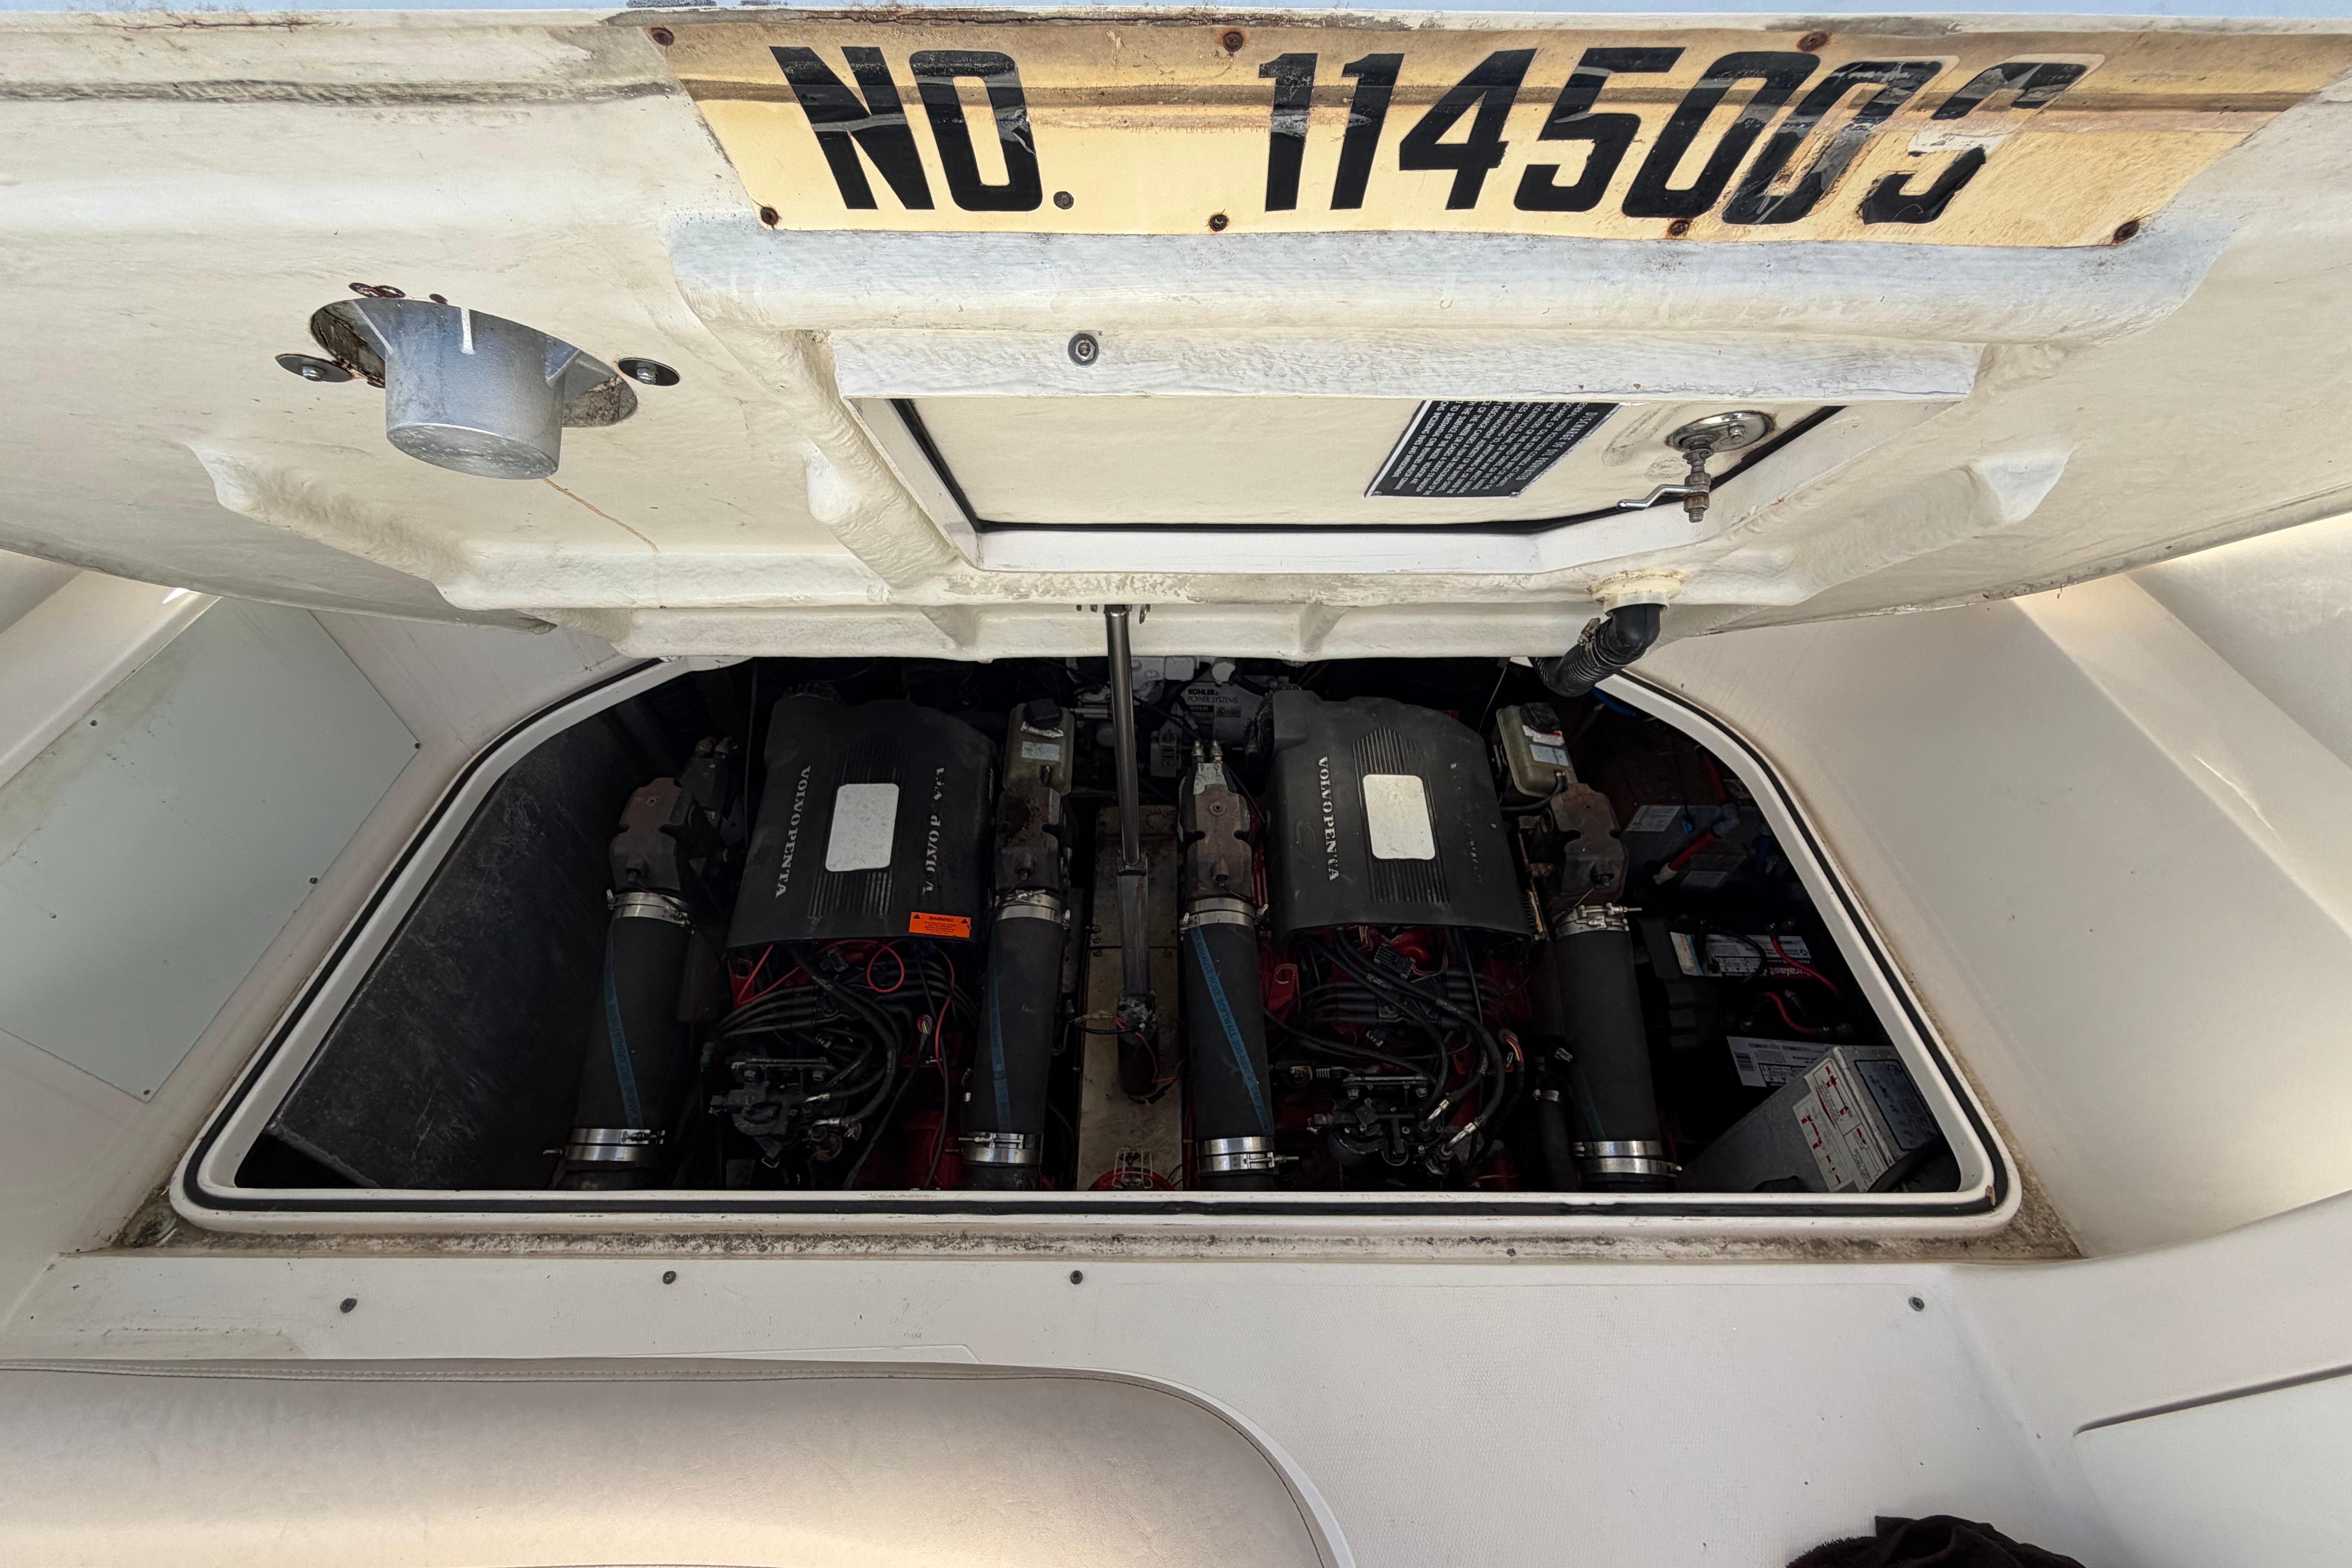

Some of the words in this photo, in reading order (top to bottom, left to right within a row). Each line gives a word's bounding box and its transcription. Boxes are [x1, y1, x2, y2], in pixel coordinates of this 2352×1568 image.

[1447, 416, 1467, 432] SURFACE
[1476, 406, 1503, 428] DISCHARGE
[1481, 411, 1512, 438] MANAGEMENT
[1496, 413, 1524, 436] BELONGING
[1512, 405, 1545, 432] CONTIGUOUS
[1529, 413, 1551, 428] WATERS
[1552, 418, 1573, 431] WATER
[1557, 412, 1600, 441] DISCHARGE
[1458, 423, 1475, 435] WATER
[1464, 429, 1483, 443] CAUSES
[1501, 433, 1519, 444] ZONE,
[1533, 432, 1559, 450] POLLUTION
[1514, 457, 1549, 480] PROHIBITED
[1197, 943, 1213, 974] EXHAUST
[1208, 976, 1220, 997] HOSE
[1217, 999, 1236, 1038] SOFTWALL
